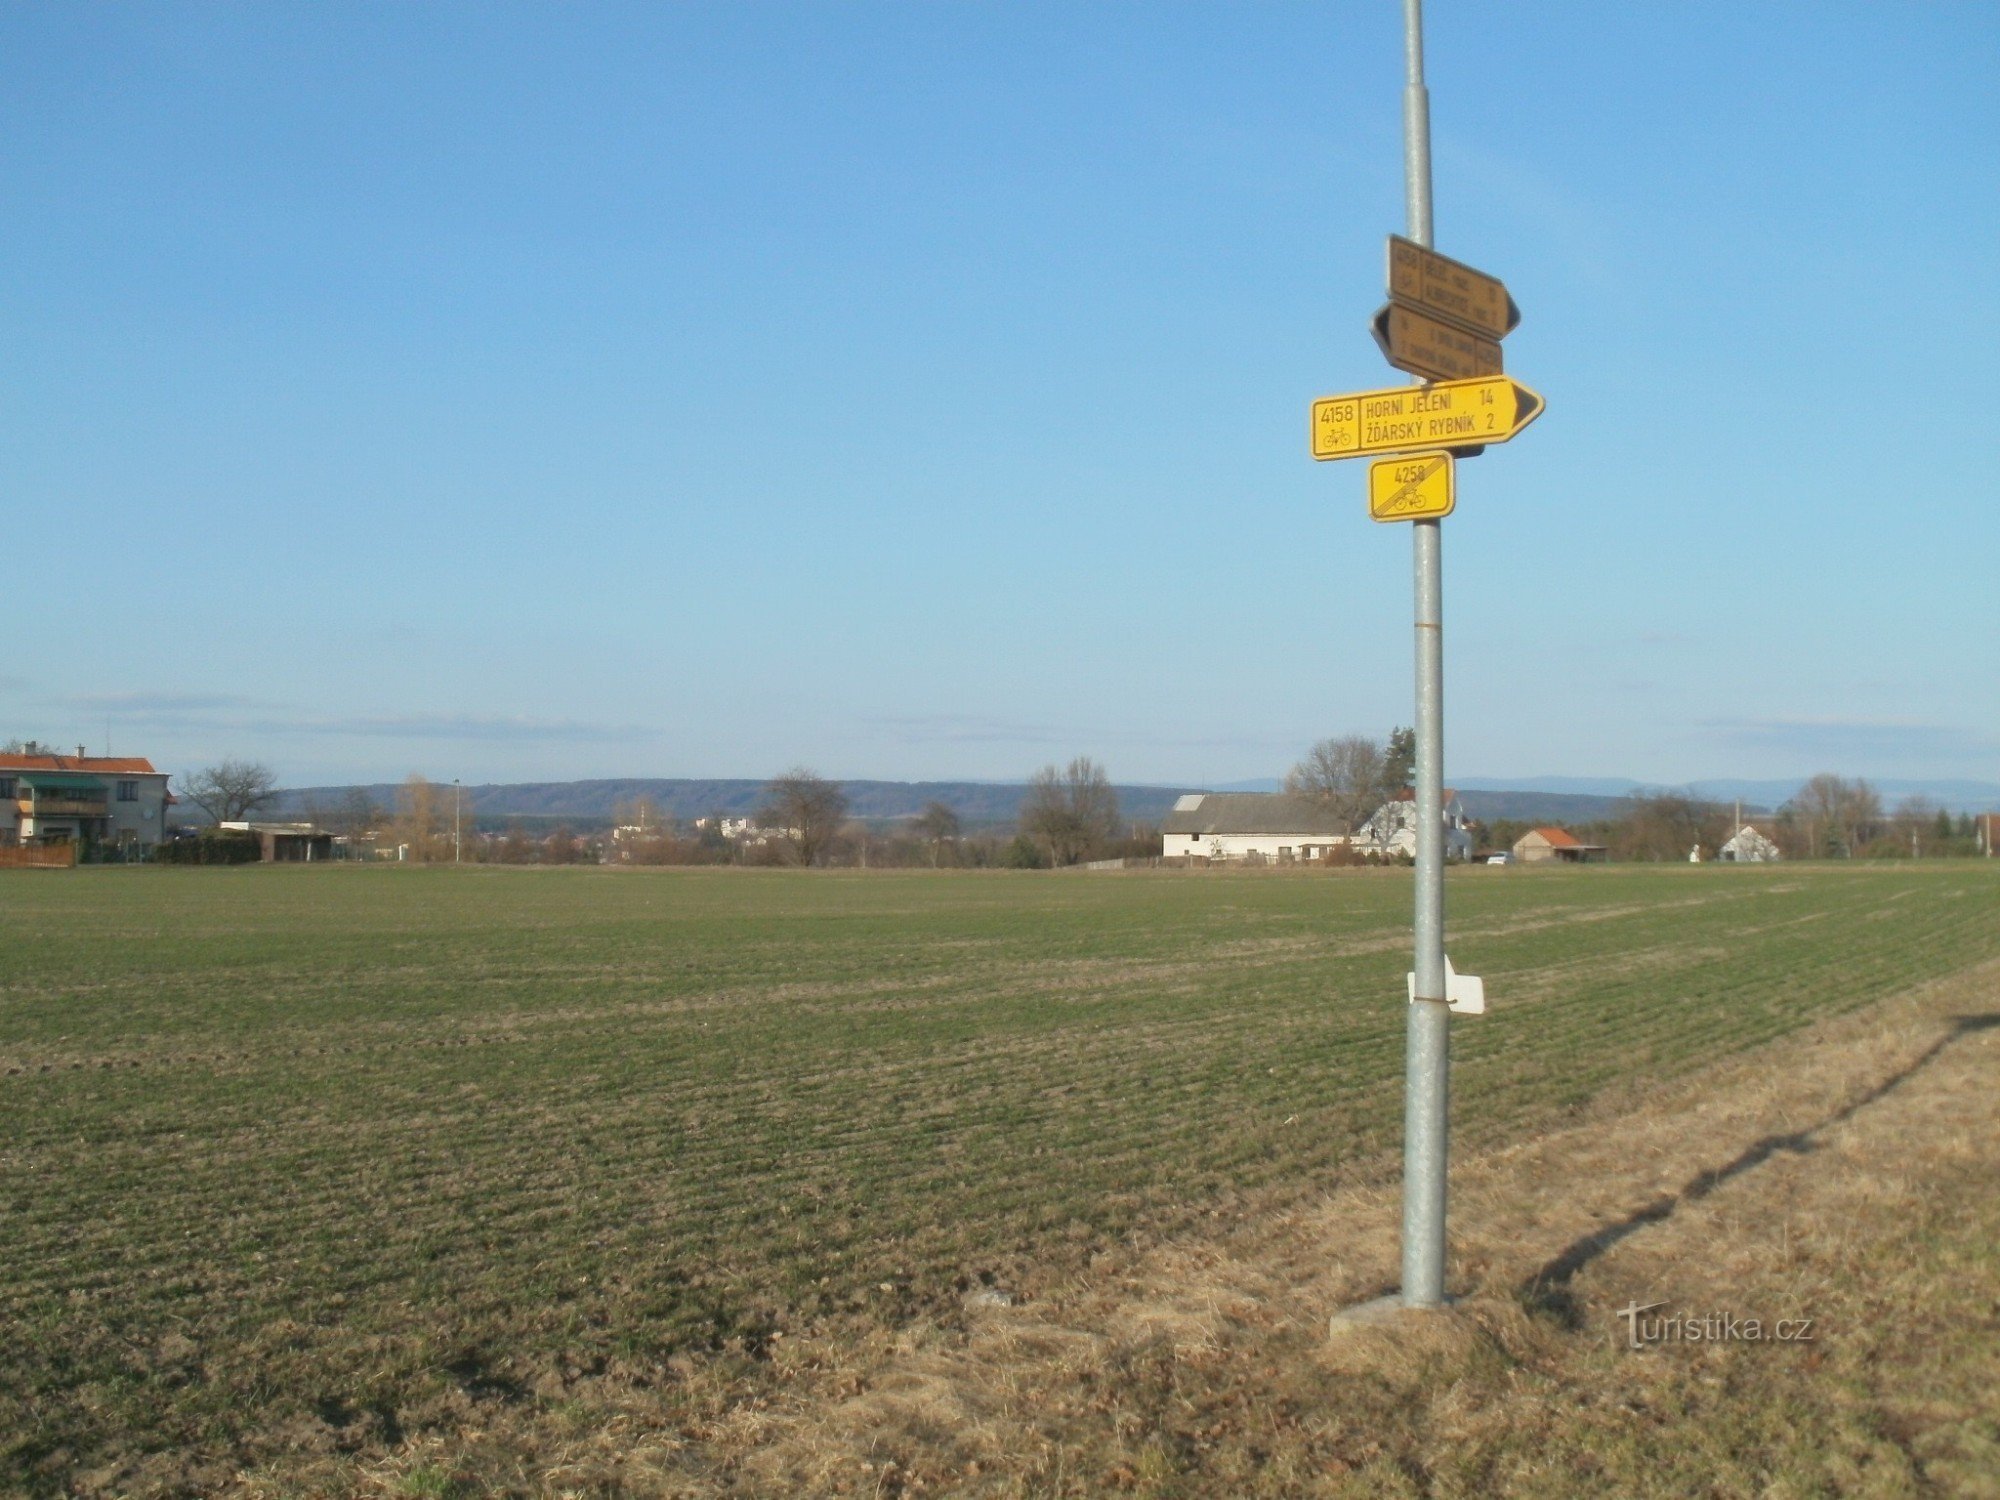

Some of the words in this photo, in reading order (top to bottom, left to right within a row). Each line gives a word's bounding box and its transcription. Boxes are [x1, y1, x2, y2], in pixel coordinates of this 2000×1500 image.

[1321, 405, 1353, 424] 4158
[1366, 395, 1403, 419] HORNÍ
[1409, 388, 1451, 414] JELENÍ
[1479, 389, 1493, 406] 14
[1366, 416, 1423, 443] ŽĎÁRSKÝ
[1430, 411, 1475, 436] RYBNÍK
[1486, 413, 1494, 430] 2
[1394, 465, 1425, 484] 4258
